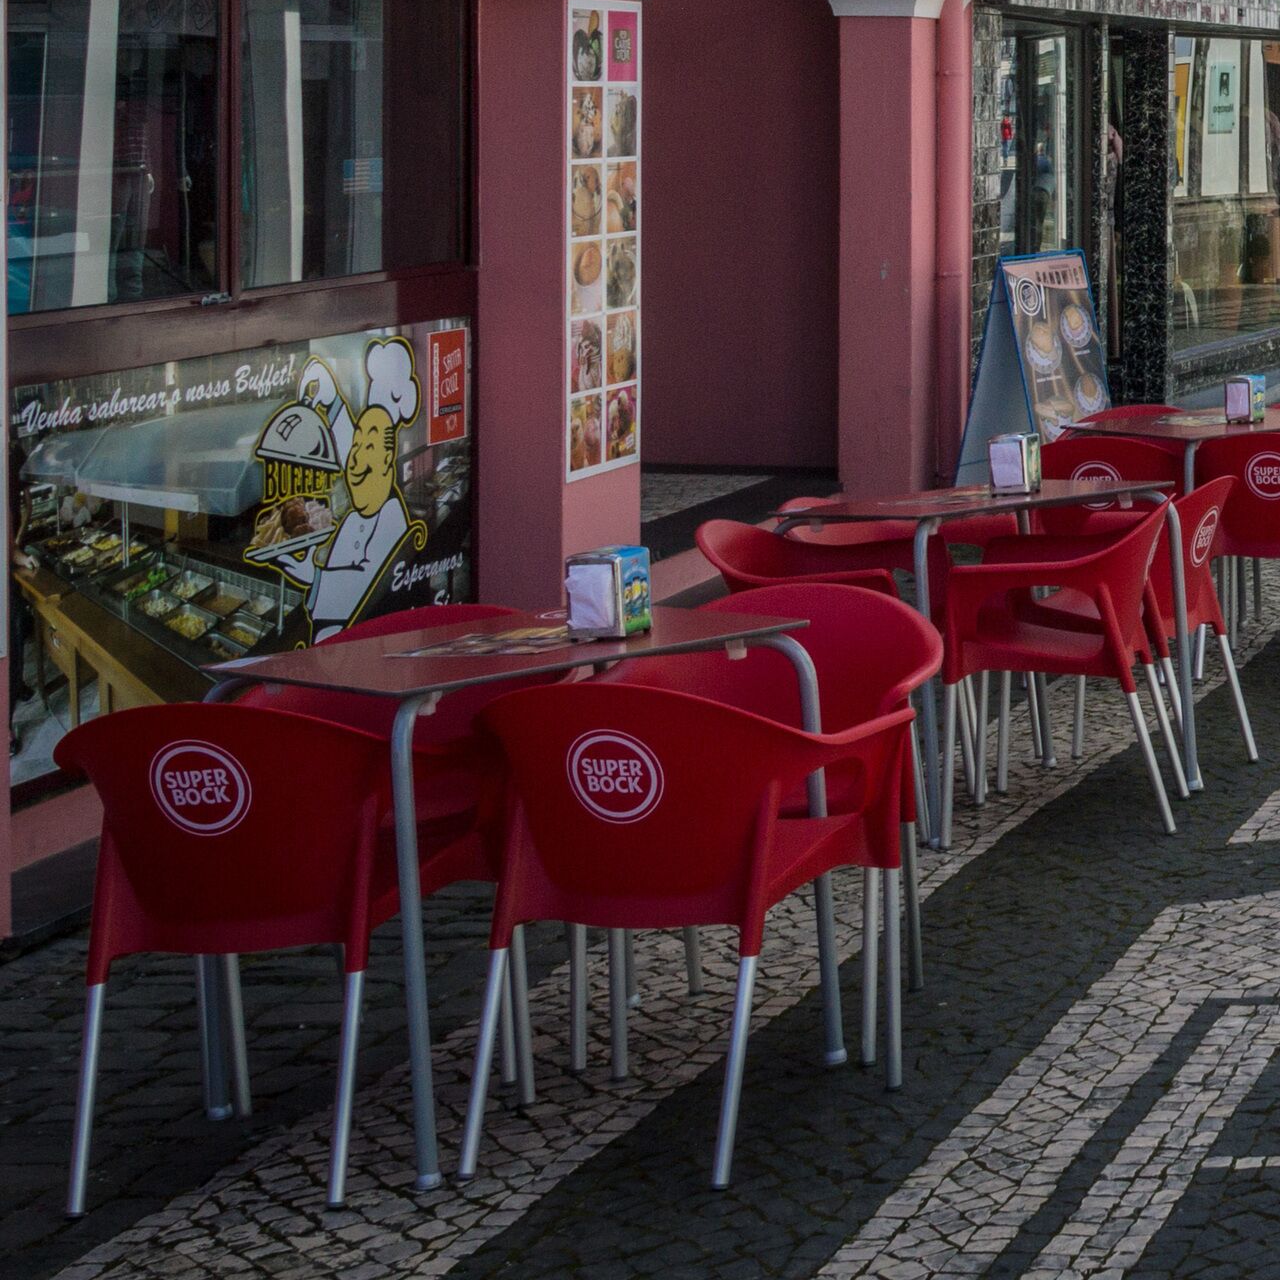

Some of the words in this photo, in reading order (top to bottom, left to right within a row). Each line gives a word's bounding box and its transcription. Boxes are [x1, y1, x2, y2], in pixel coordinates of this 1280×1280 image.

[22, 397, 83, 433] Venha
[88, 387, 167, 418] saborear
[170, 388, 181, 406] o
[185, 381, 230, 403] nosso
[235, 354, 296, 396] Buffet!
[264, 460, 335, 500] BUFFET
[391, 552, 464, 592] Esperamos
[581, 758, 644, 776] SUPER
[164, 768, 230, 789] SUPER
[586, 775, 644, 793] BOCK
[171, 786, 232, 806] BOCK
